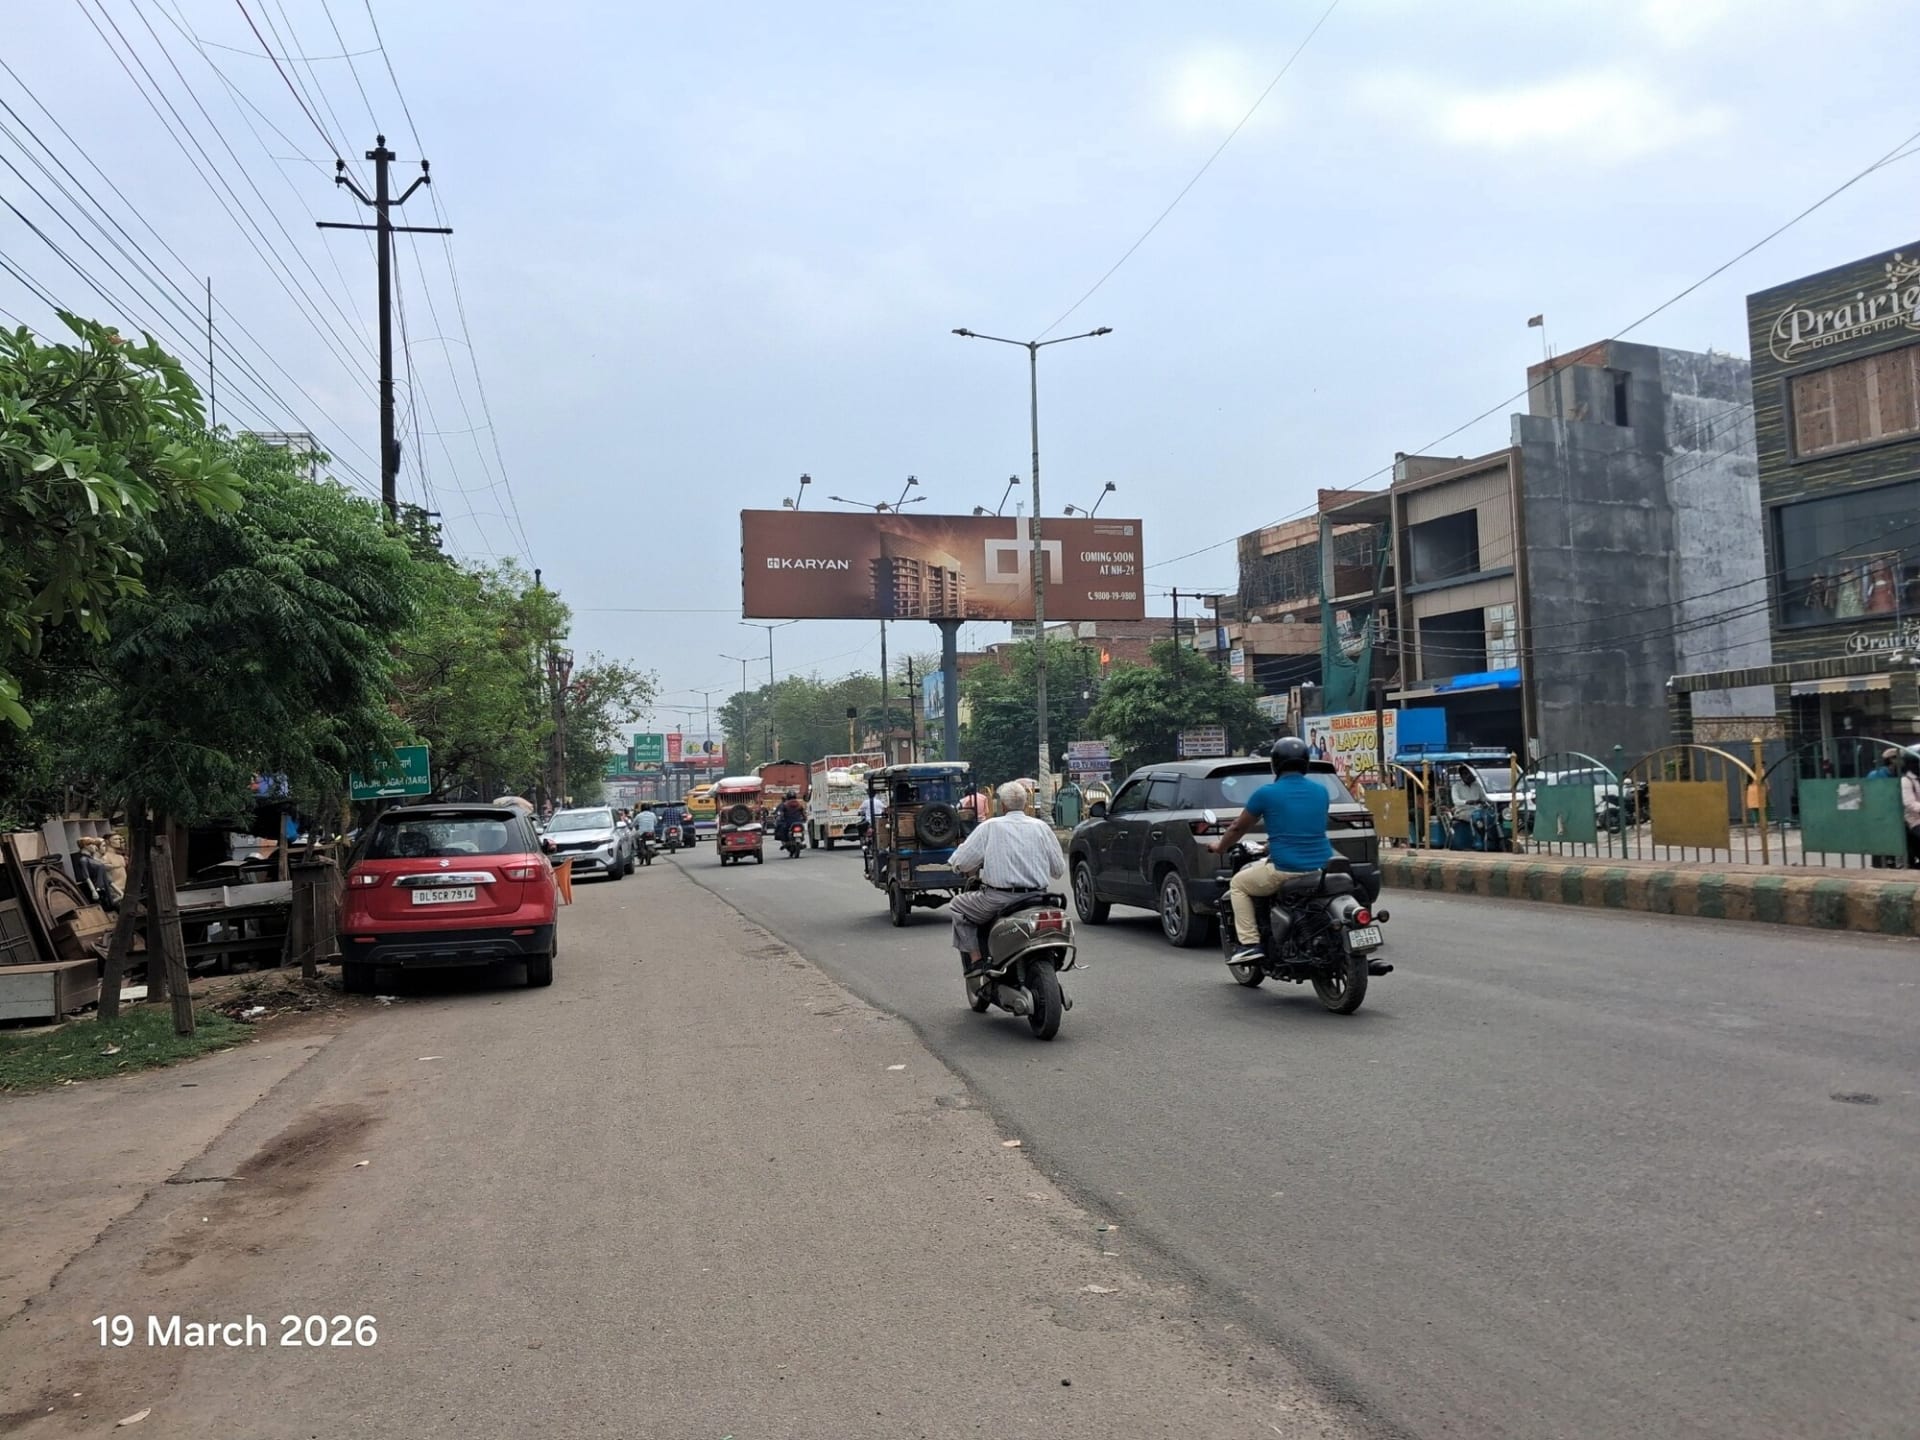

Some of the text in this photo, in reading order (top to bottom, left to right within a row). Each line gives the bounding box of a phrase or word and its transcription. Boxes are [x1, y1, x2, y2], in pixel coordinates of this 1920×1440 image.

[1080, 551, 1135, 563] COMING SOON
[781, 558, 849, 570] KARYAN
[1099, 564, 1110, 575] AT
[1336, 730, 1377, 752] LAPTO
[451, 889, 474, 900] 7914
